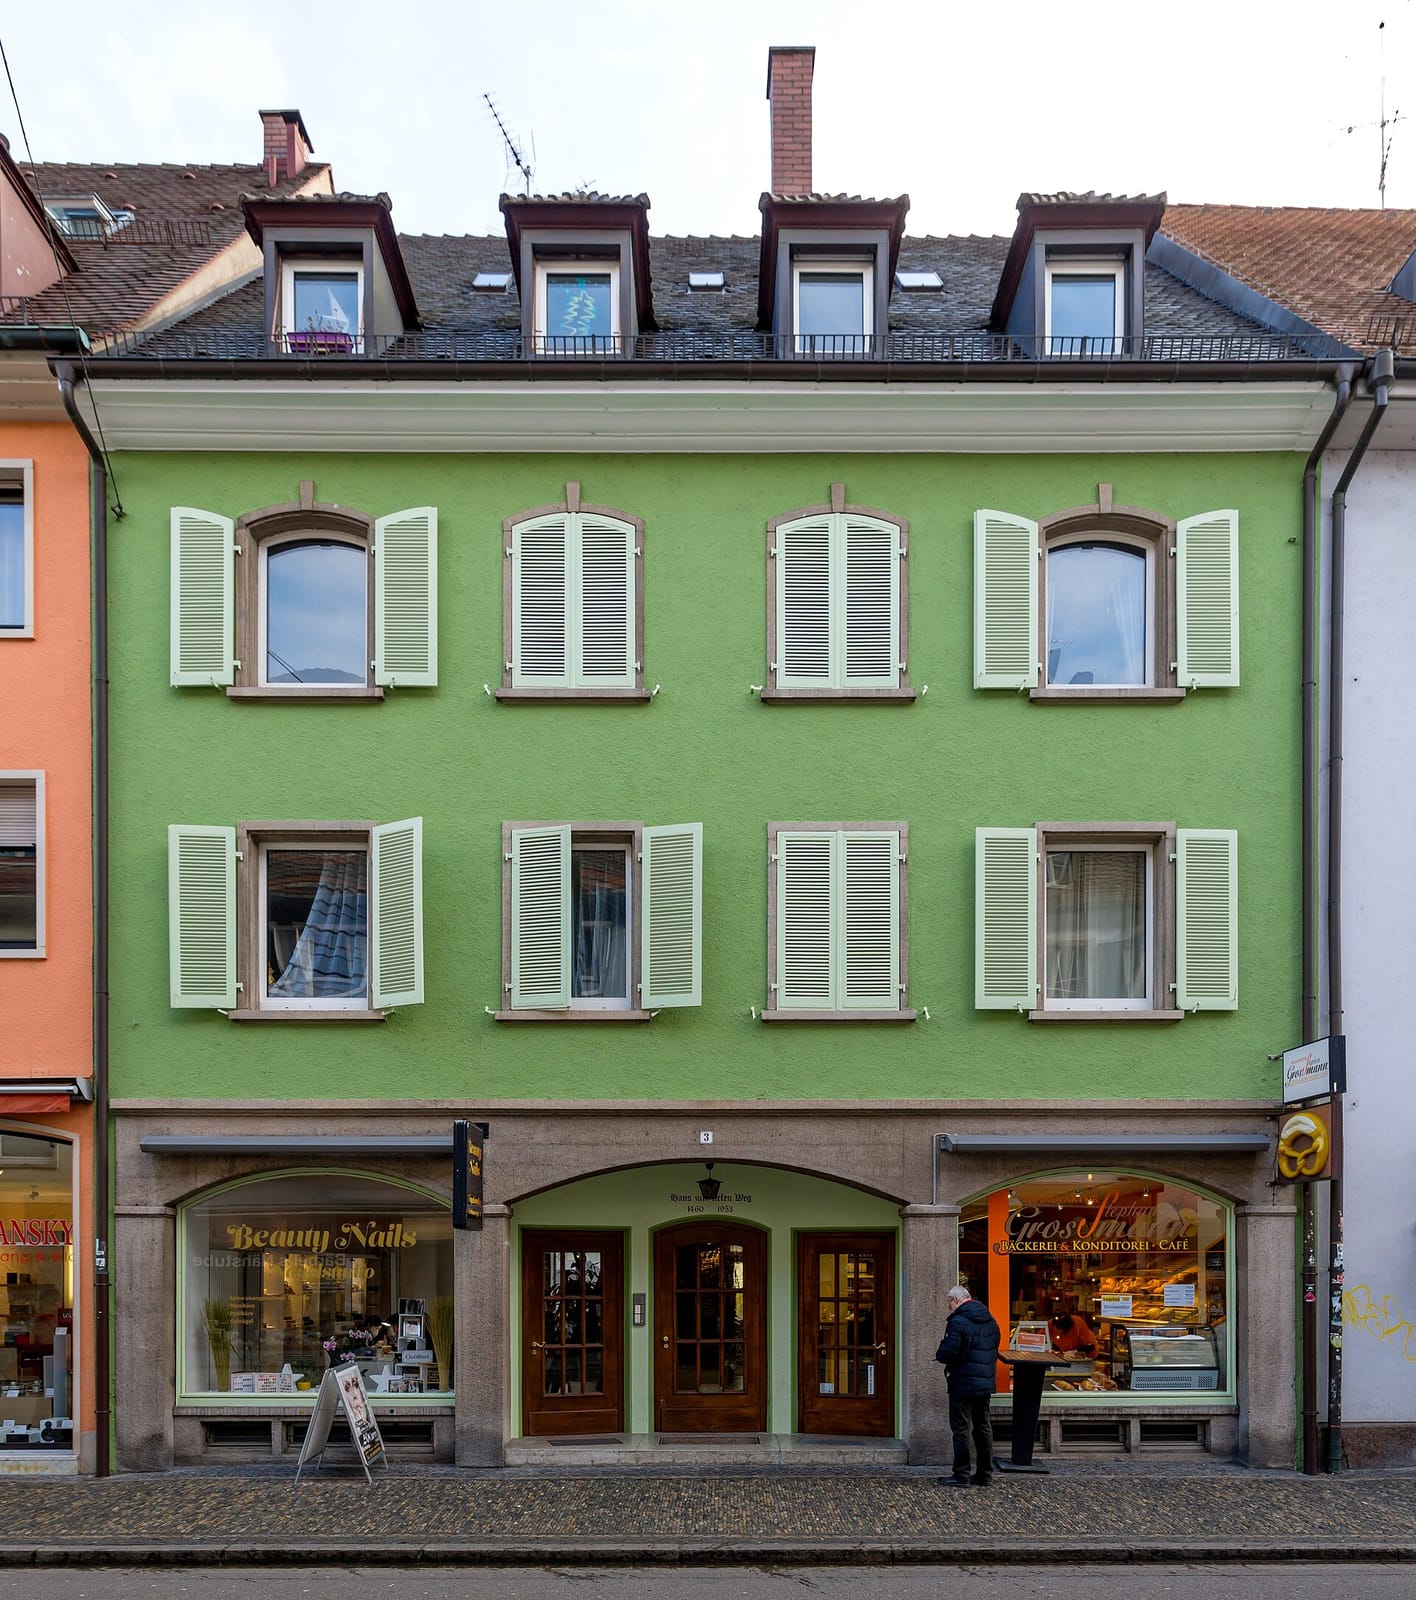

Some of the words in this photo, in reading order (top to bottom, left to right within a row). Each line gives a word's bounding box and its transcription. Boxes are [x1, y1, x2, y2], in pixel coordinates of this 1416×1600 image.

[703, 1132, 710, 1142] 3
[717, 1205, 734, 1213] 1953
[226, 1223, 330, 1254] Beauty
[334, 1221, 417, 1250] Nails
[1001, 1239, 1058, 1251] BÄCKEREI
[1072, 1239, 1149, 1251] KONDITOREI
[1158, 1239, 1189, 1251] CAFÉ
